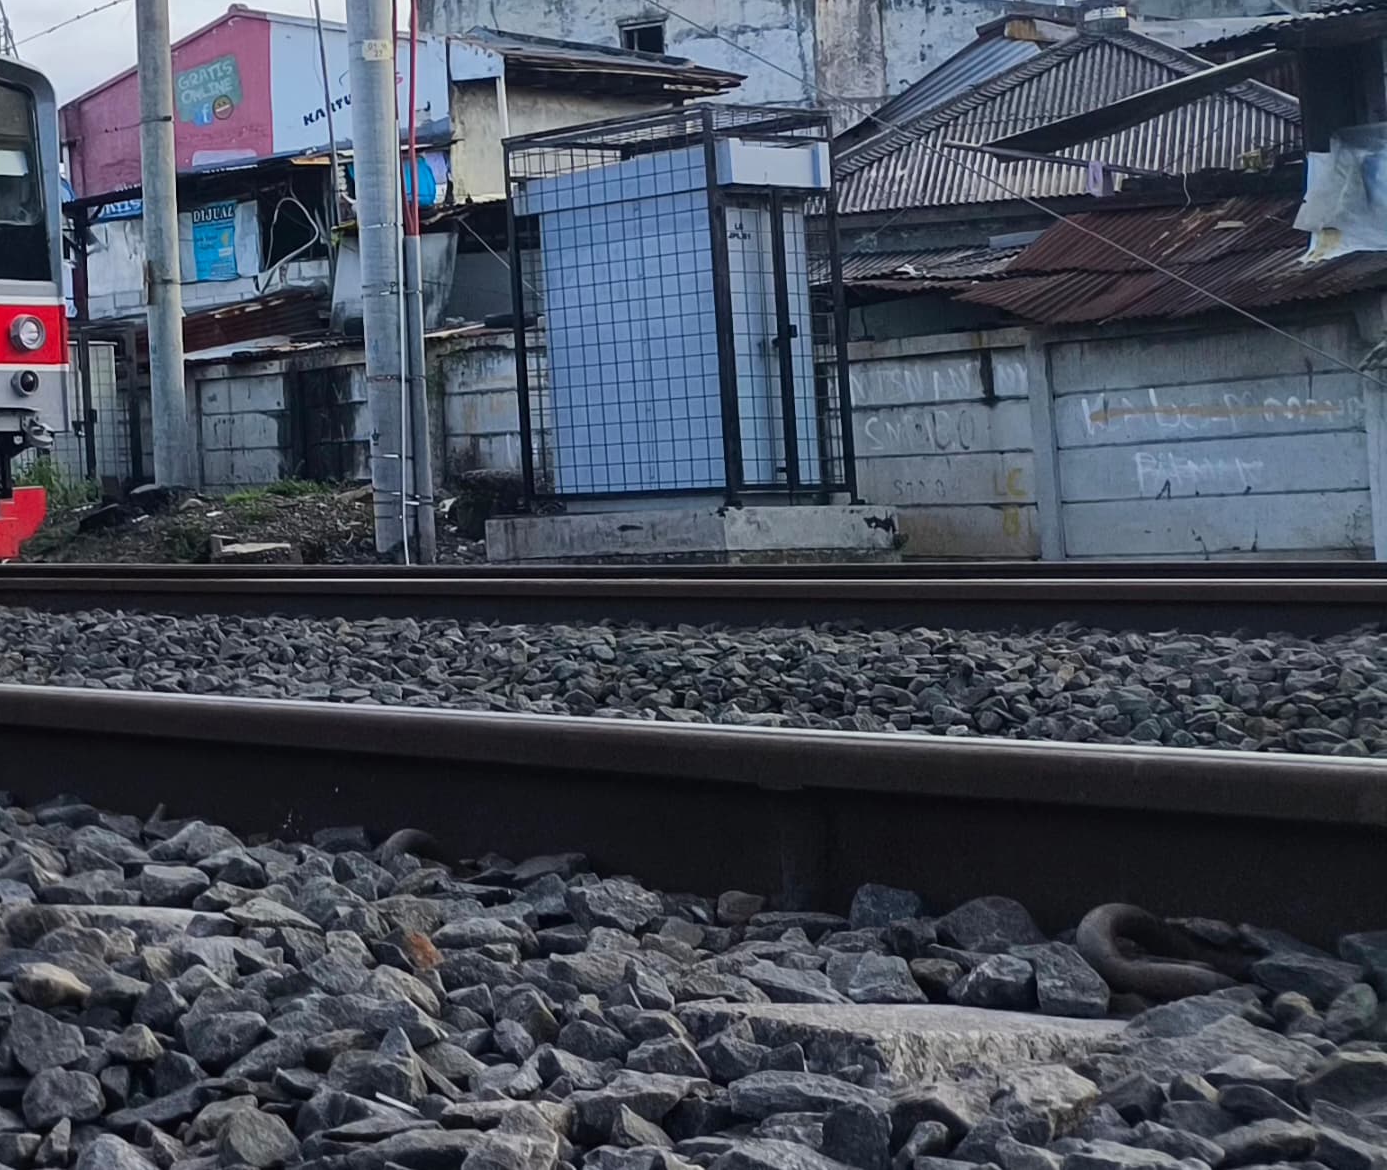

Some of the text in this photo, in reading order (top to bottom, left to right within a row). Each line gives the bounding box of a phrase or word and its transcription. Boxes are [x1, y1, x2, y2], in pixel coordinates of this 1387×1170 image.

[178, 60, 233, 90] GRATIS
[181, 77, 233, 105] ONLINE
[193, 203, 236, 224] DIJUAL
